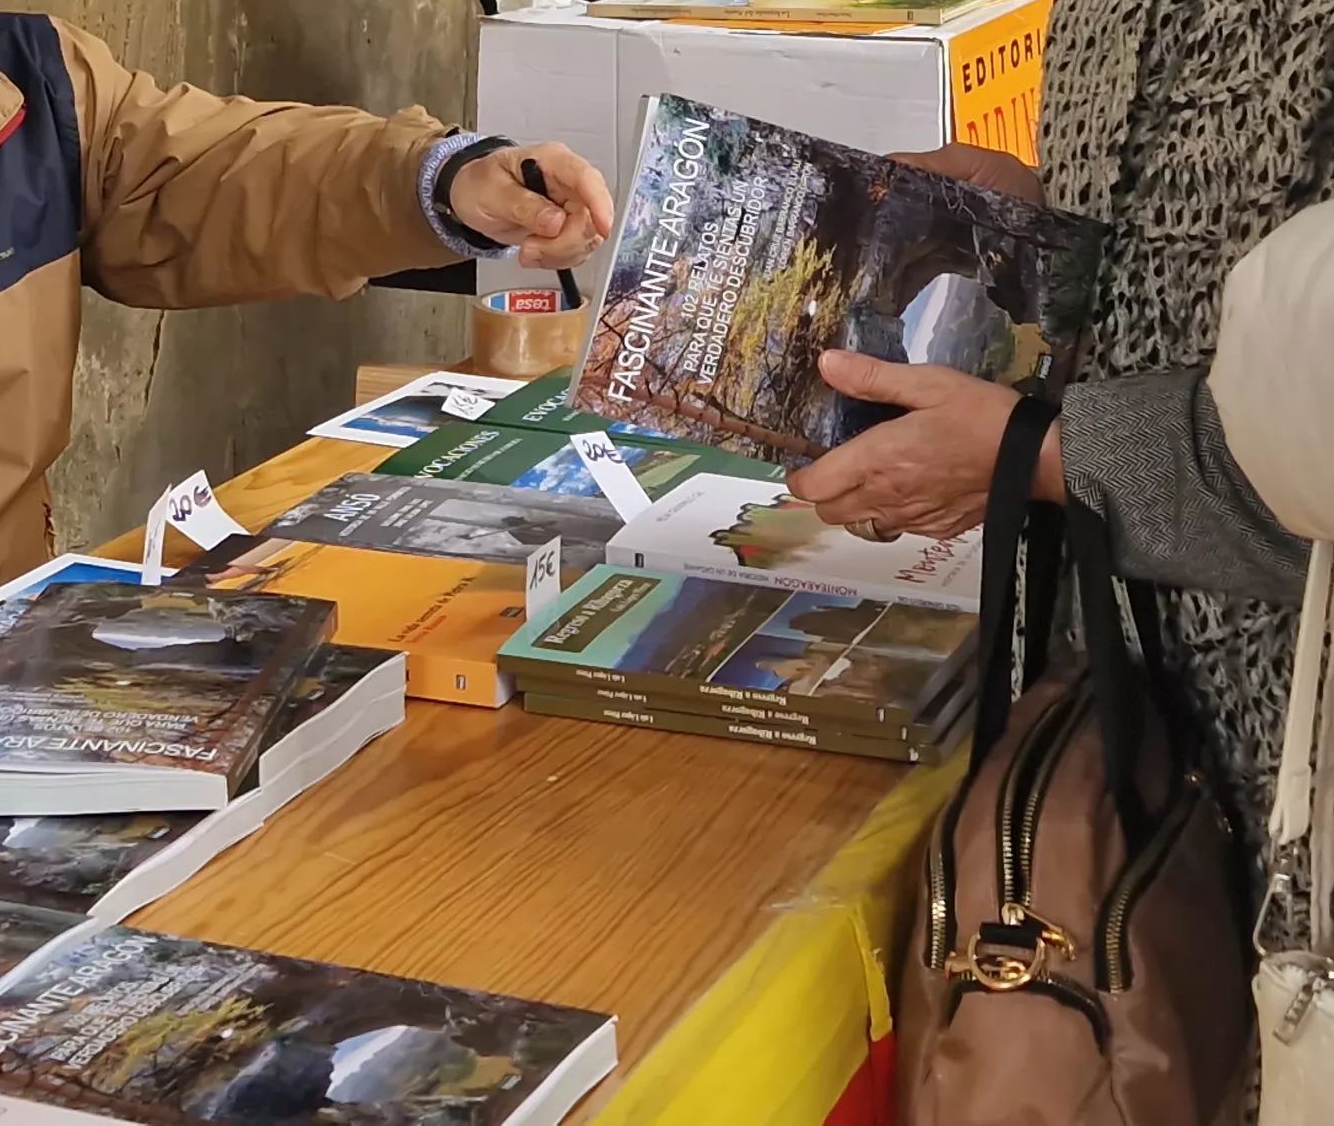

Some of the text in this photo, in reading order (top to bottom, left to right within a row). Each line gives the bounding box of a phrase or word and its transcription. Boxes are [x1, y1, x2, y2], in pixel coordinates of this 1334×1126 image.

[961, 27, 1042, 94] EDITORI
[608, 118, 710, 402] FASCINANTE ARAGÓN
[680, 222, 719, 320] 102 RELATOS
[683, 179, 749, 372] PARA QUE TE SIENTAS UN
[697, 176, 768, 385] VERDADERO DESCUBRIDOR
[515, 298, 551, 310] tesa
[418, 430, 500, 479] VOCACIONES
[322, 491, 382, 522] ANSÓ
[529, 550, 557, 591] 15€
[44, 736, 218, 761] FASCINANTE
